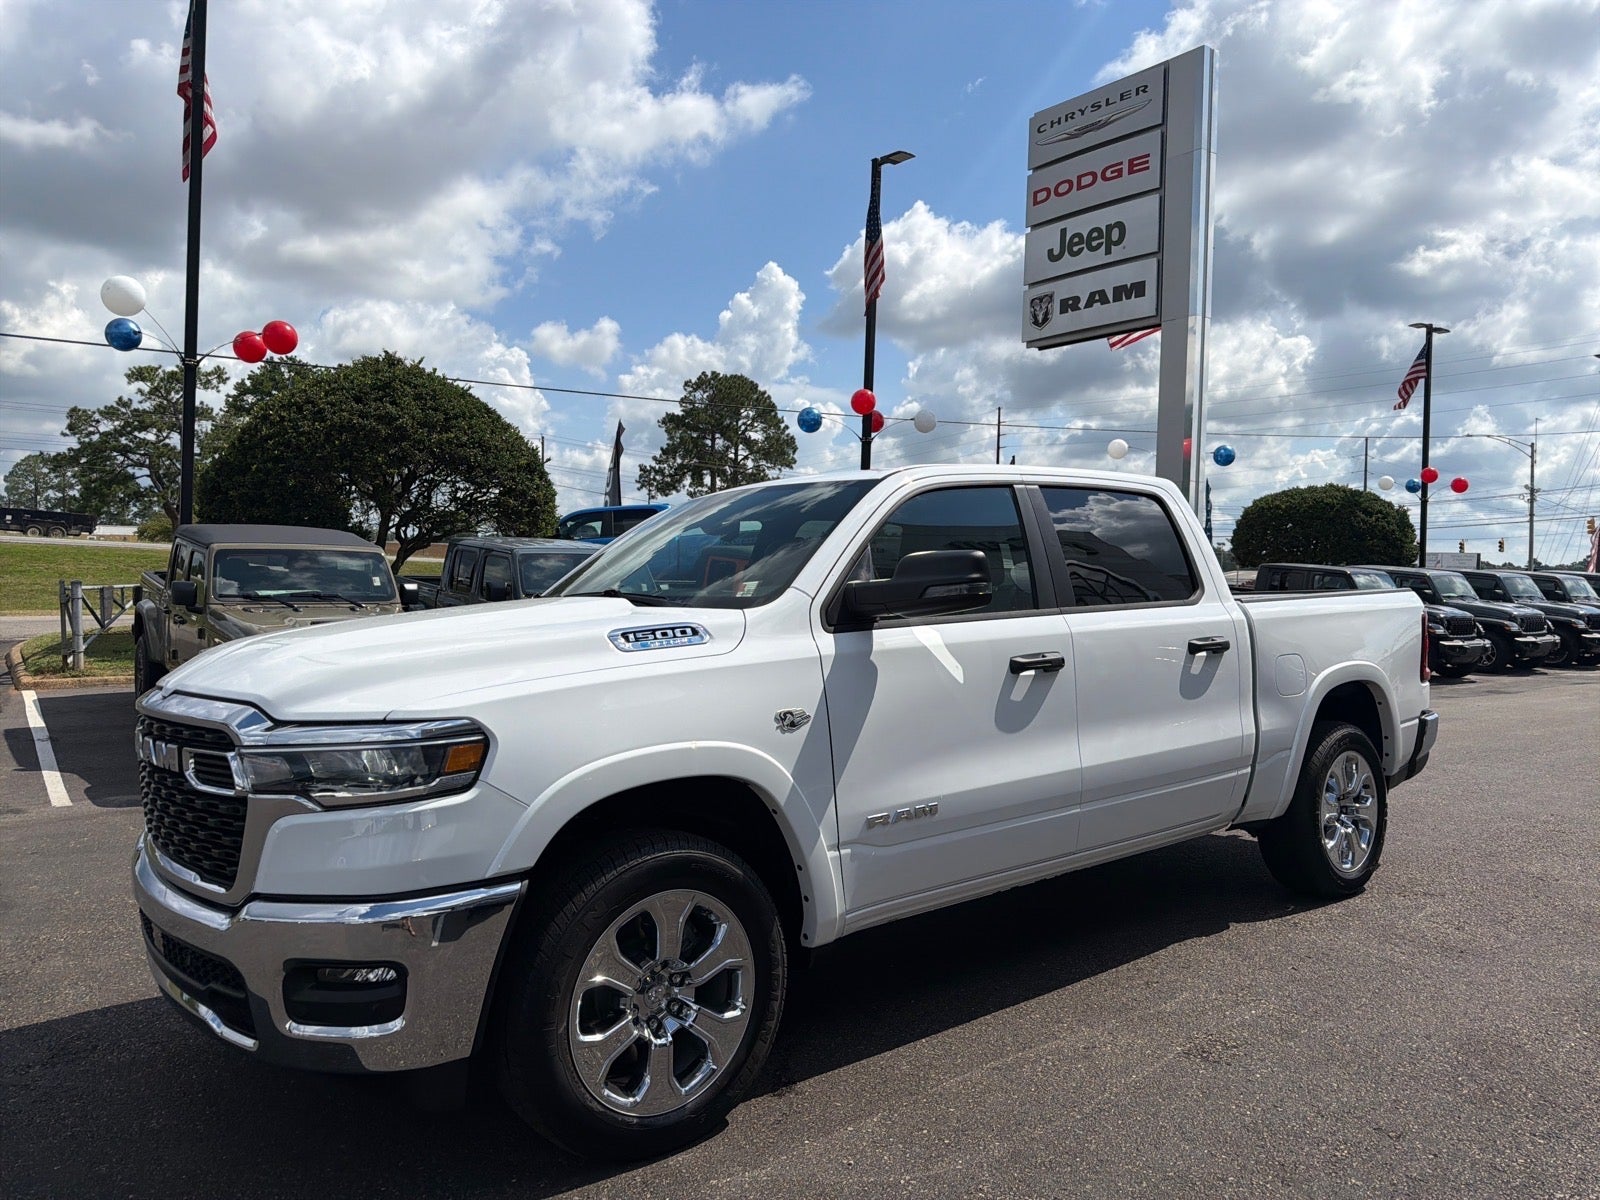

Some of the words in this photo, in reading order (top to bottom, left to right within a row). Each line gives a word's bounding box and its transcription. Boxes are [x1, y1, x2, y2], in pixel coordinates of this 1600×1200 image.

[1036, 84, 1149, 134] CHRYSLER
[1032, 153, 1150, 207] DODGE
[1047, 220, 1126, 263] Jeep
[1059, 280, 1146, 315] RAM
[624, 627, 693, 642] 1500
[865, 802, 938, 829] RAM
